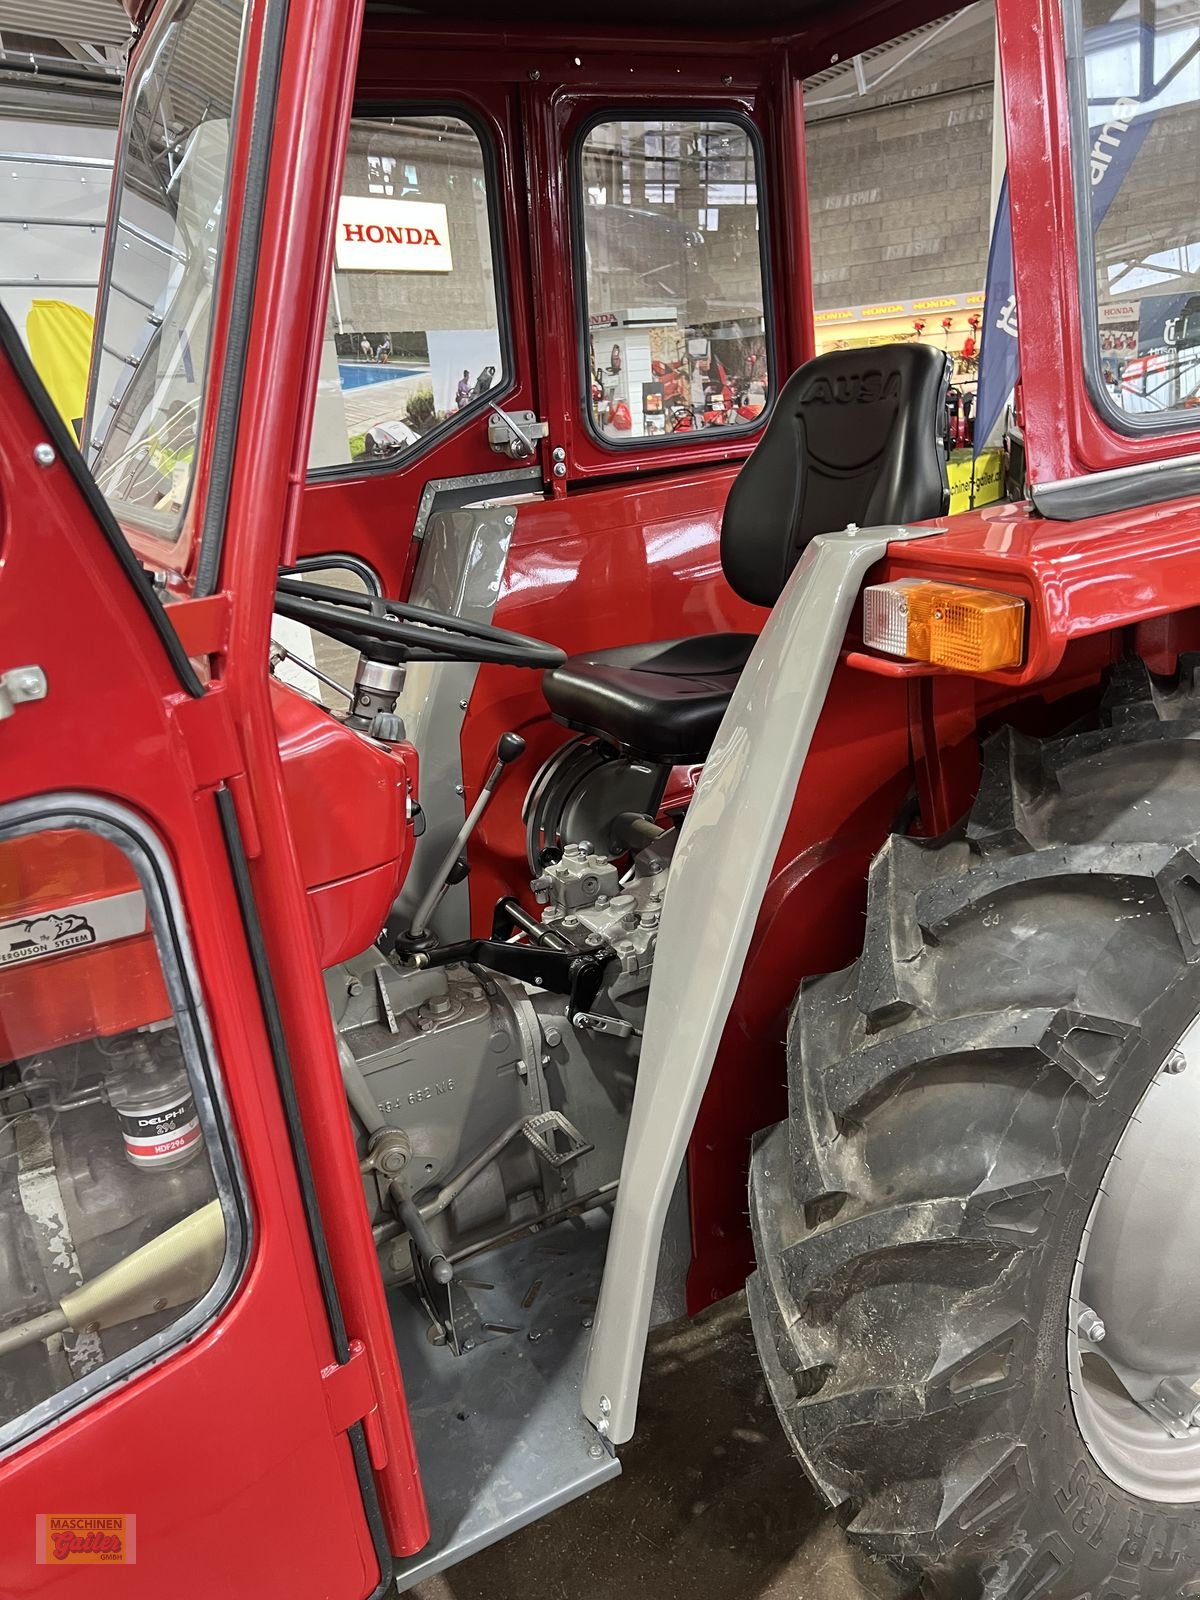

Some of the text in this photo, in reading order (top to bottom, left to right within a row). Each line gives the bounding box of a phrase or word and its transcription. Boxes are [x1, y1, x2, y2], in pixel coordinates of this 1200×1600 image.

[343, 224, 442, 246] HONDA
[862, 305, 904, 316] HONDA
[913, 298, 957, 310] HONDA
[589, 313, 617, 324] NDA
[815, 311, 853, 321] HONDA
[1104, 307, 1134, 316] HONDA
[55, 934, 88, 948] SYSTEM
[408, 1086, 432, 1104] 682
[138, 1107, 185, 1126] DELPHI
[156, 1120, 176, 1135] 296
[154, 1138, 185, 1153] HDF296
